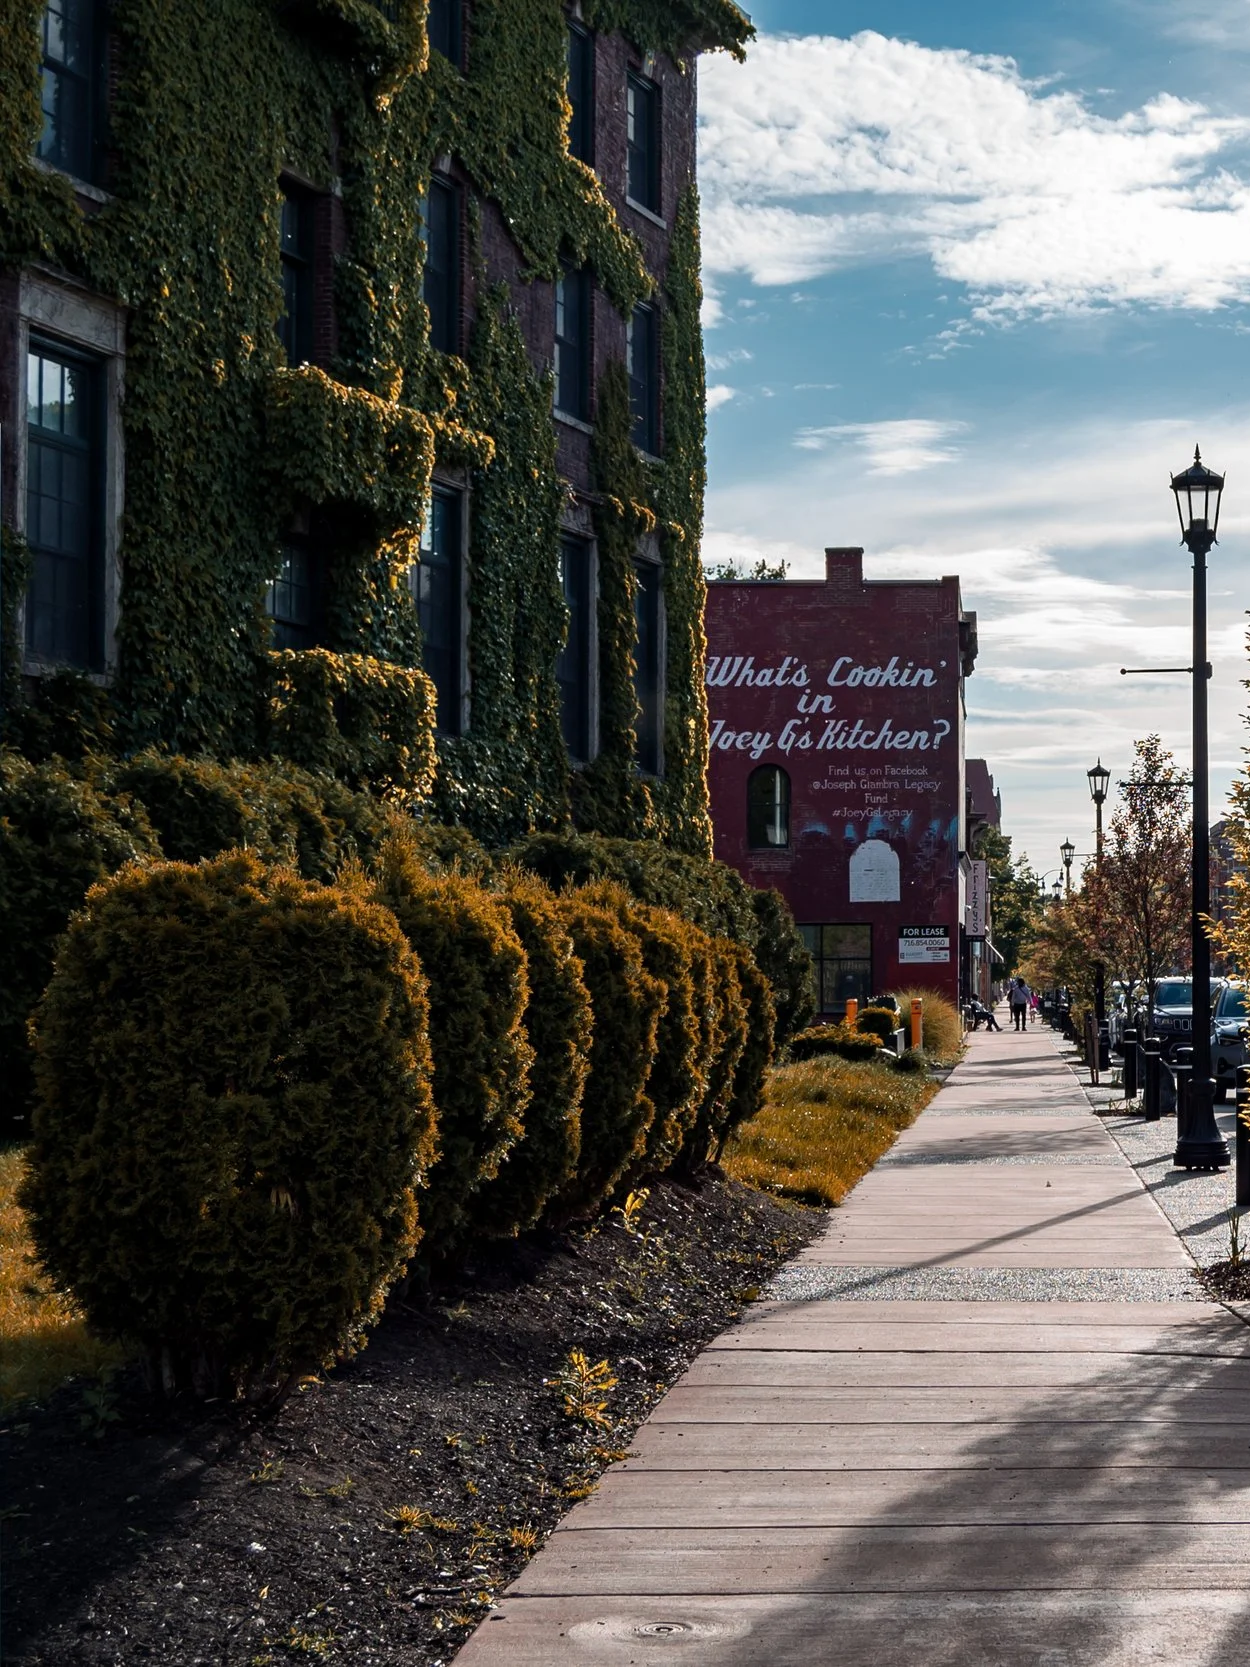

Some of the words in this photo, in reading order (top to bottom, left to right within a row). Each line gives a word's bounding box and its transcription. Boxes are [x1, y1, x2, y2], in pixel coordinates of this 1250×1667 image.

[706, 656, 811, 688] What's
[827, 656, 948, 688] Cookin'
[797, 688, 837, 714] in
[709, 719, 775, 760] Joey
[816, 719, 952, 751] Kitchen?
[828, 765, 850, 776] Find
[855, 767, 867, 776] us
[870, 767, 883, 776] on
[884, 764, 929, 776] Facebook
[812, 779, 857, 793] @Joseph
[904, 779, 942, 794] Legacy
[864, 793, 889, 804] Fund
[903, 928, 920, 936] FOR
[921, 927, 945, 936] LEASE
